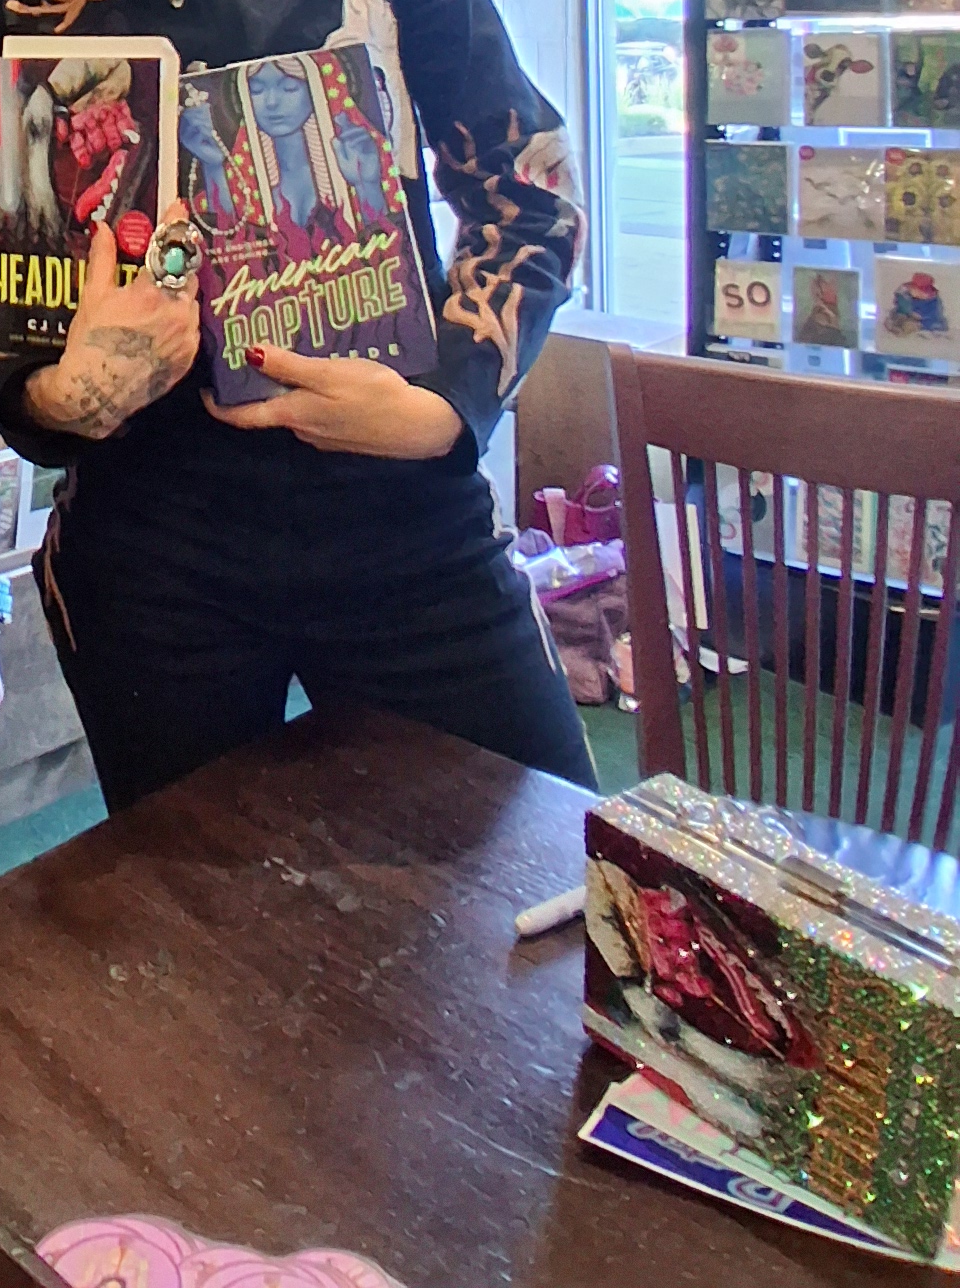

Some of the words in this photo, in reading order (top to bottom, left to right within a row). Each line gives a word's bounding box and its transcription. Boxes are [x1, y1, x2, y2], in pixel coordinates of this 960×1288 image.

[210, 230, 399, 317] American
[222, 255, 408, 371] RAPTURE
[721, 280, 772, 309] SO
